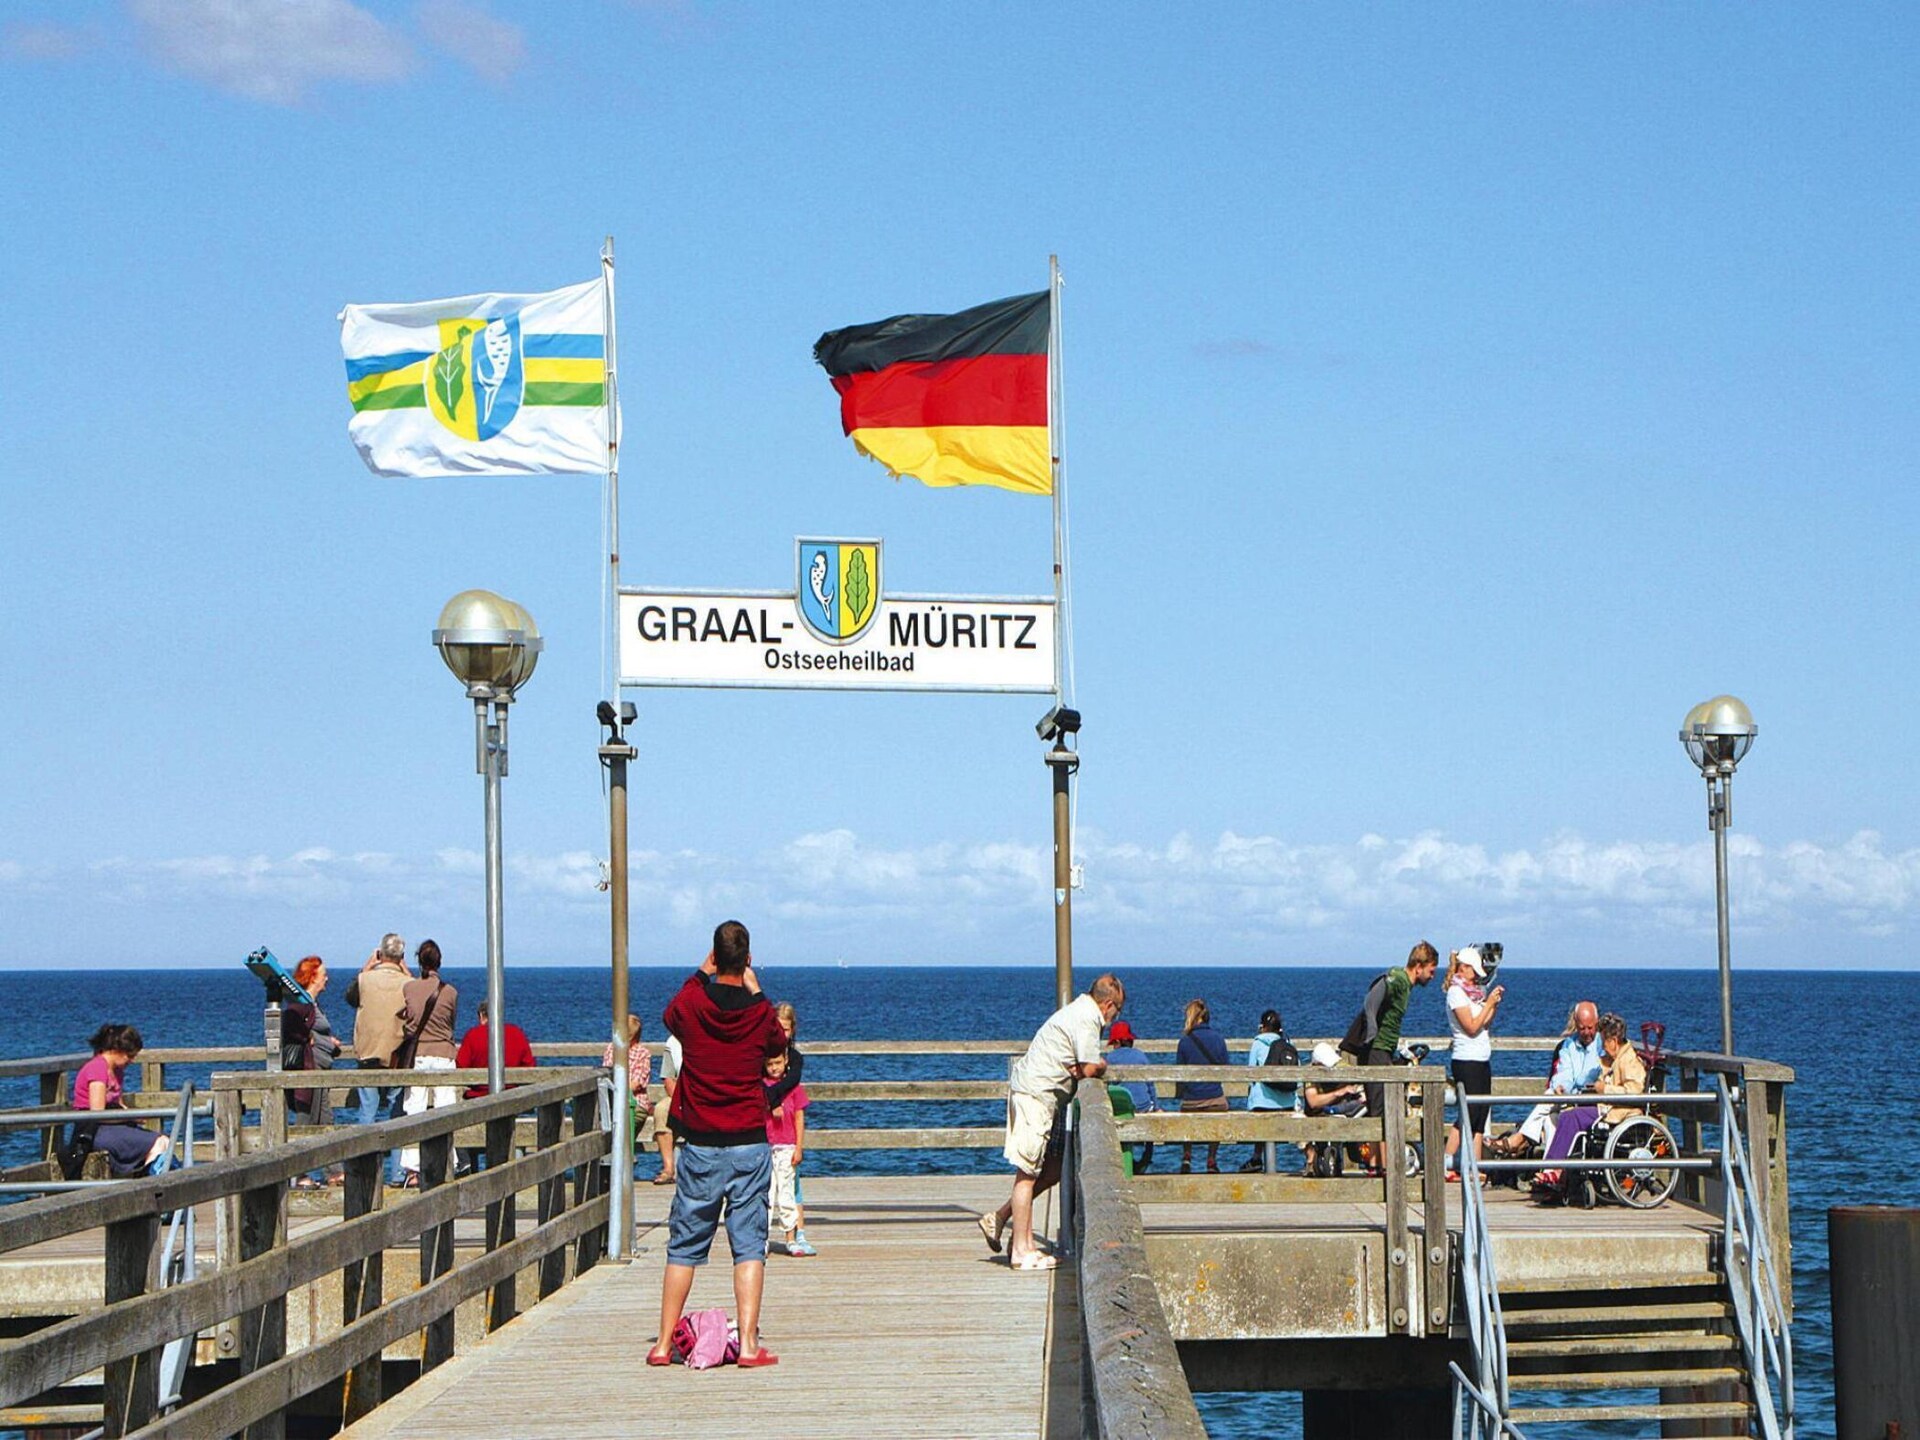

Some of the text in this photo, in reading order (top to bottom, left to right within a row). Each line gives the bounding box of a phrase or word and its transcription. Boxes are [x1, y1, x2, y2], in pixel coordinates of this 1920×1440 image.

[637, 605, 1037, 649] GRAAL- MÜRITZ
[764, 648, 914, 672] Ostseeheilbad
